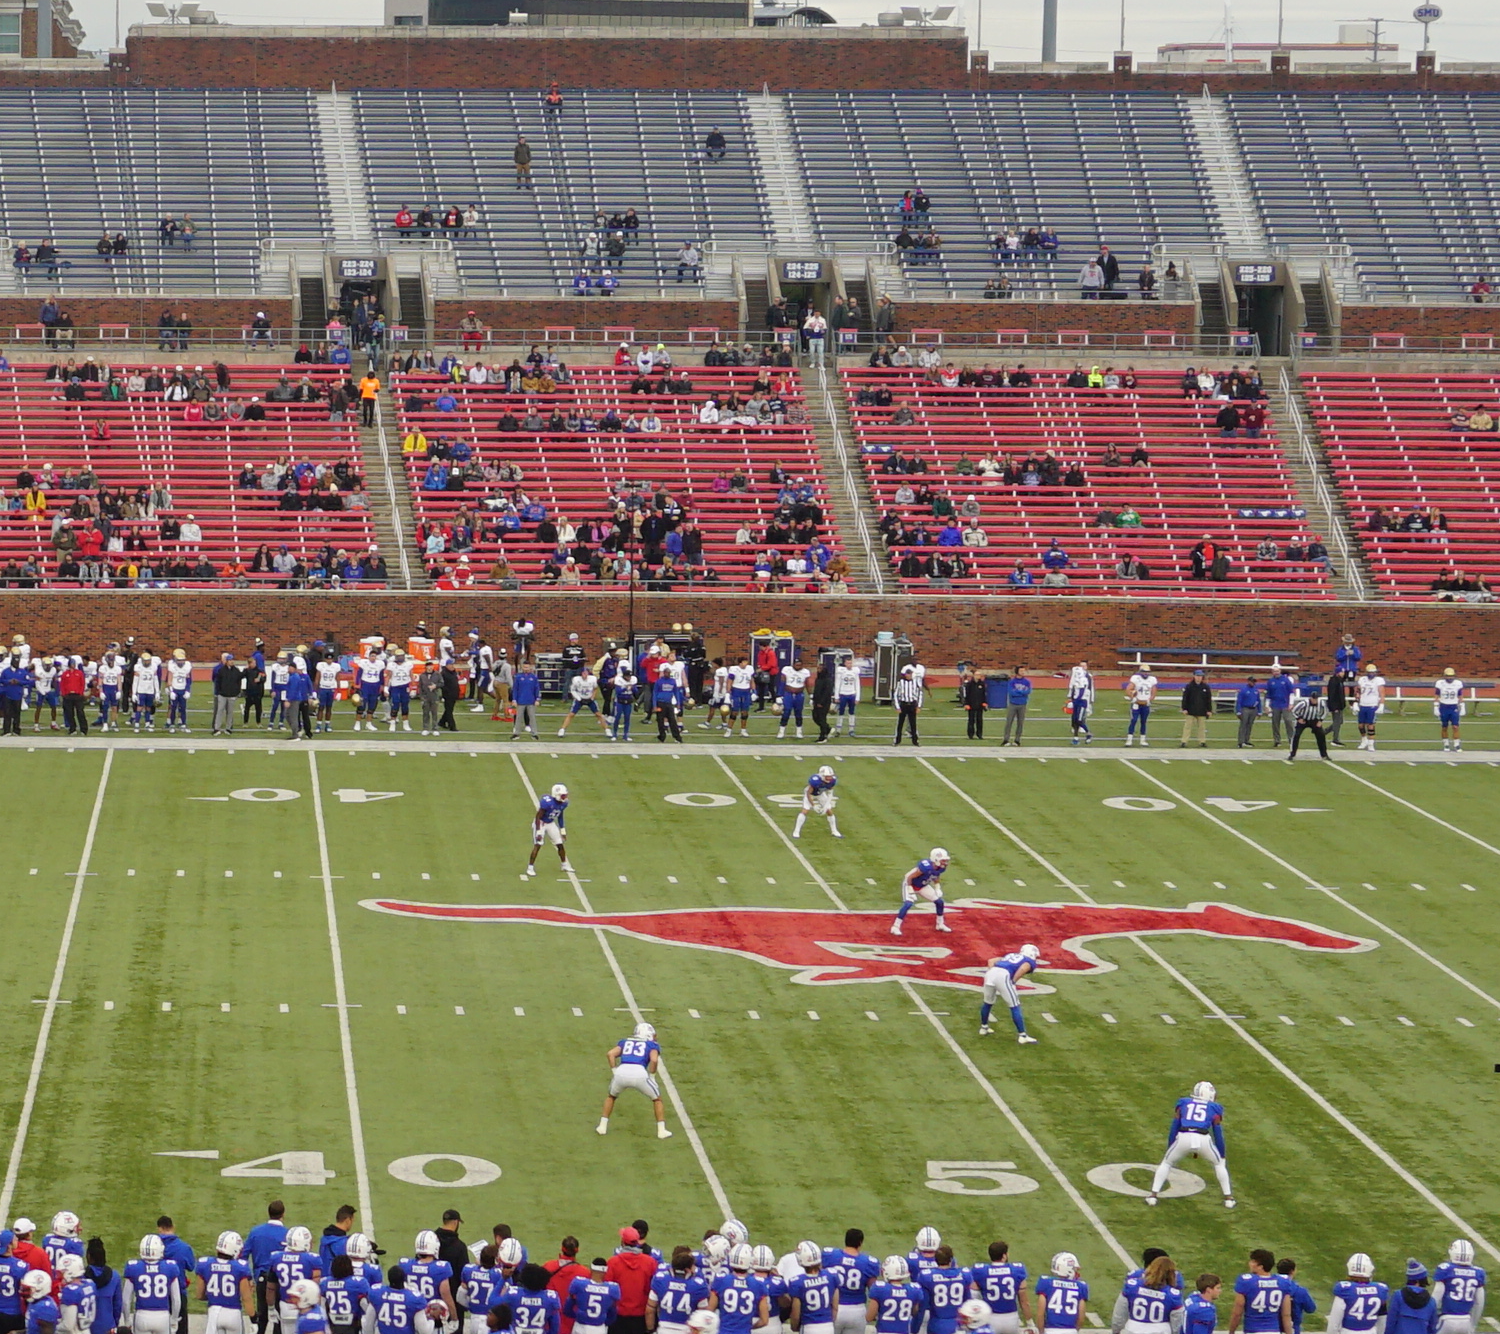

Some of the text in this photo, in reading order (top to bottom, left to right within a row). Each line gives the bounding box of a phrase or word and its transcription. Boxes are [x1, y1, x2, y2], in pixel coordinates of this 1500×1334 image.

[622, 1040, 645, 1057] 83
[1186, 1104, 1206, 1121] 15
[220, 1150, 503, 1188] 40
[925, 1159, 1206, 1198] 50
[138, 1274, 167, 1298] 38
[206, 1273, 235, 1297] 46
[276, 1263, 304, 1287] 35
[468, 1280, 495, 1306] 27
[805, 1286, 829, 1311] 91
[933, 1282, 964, 1307] 89
[986, 1276, 1015, 1300] 53
[1449, 1278, 1476, 1301] 36
[325, 1290, 352, 1315] 25
[660, 1292, 692, 1315] 44
[723, 1295, 755, 1320] 93
[883, 1298, 912, 1321] 28
[1048, 1289, 1079, 1315] 45
[1132, 1297, 1164, 1323] 60
[1251, 1289, 1283, 1314] 49
[1348, 1296, 1381, 1321] 42
[378, 1302, 408, 1328] 45
[515, 1307, 547, 1328] 34
